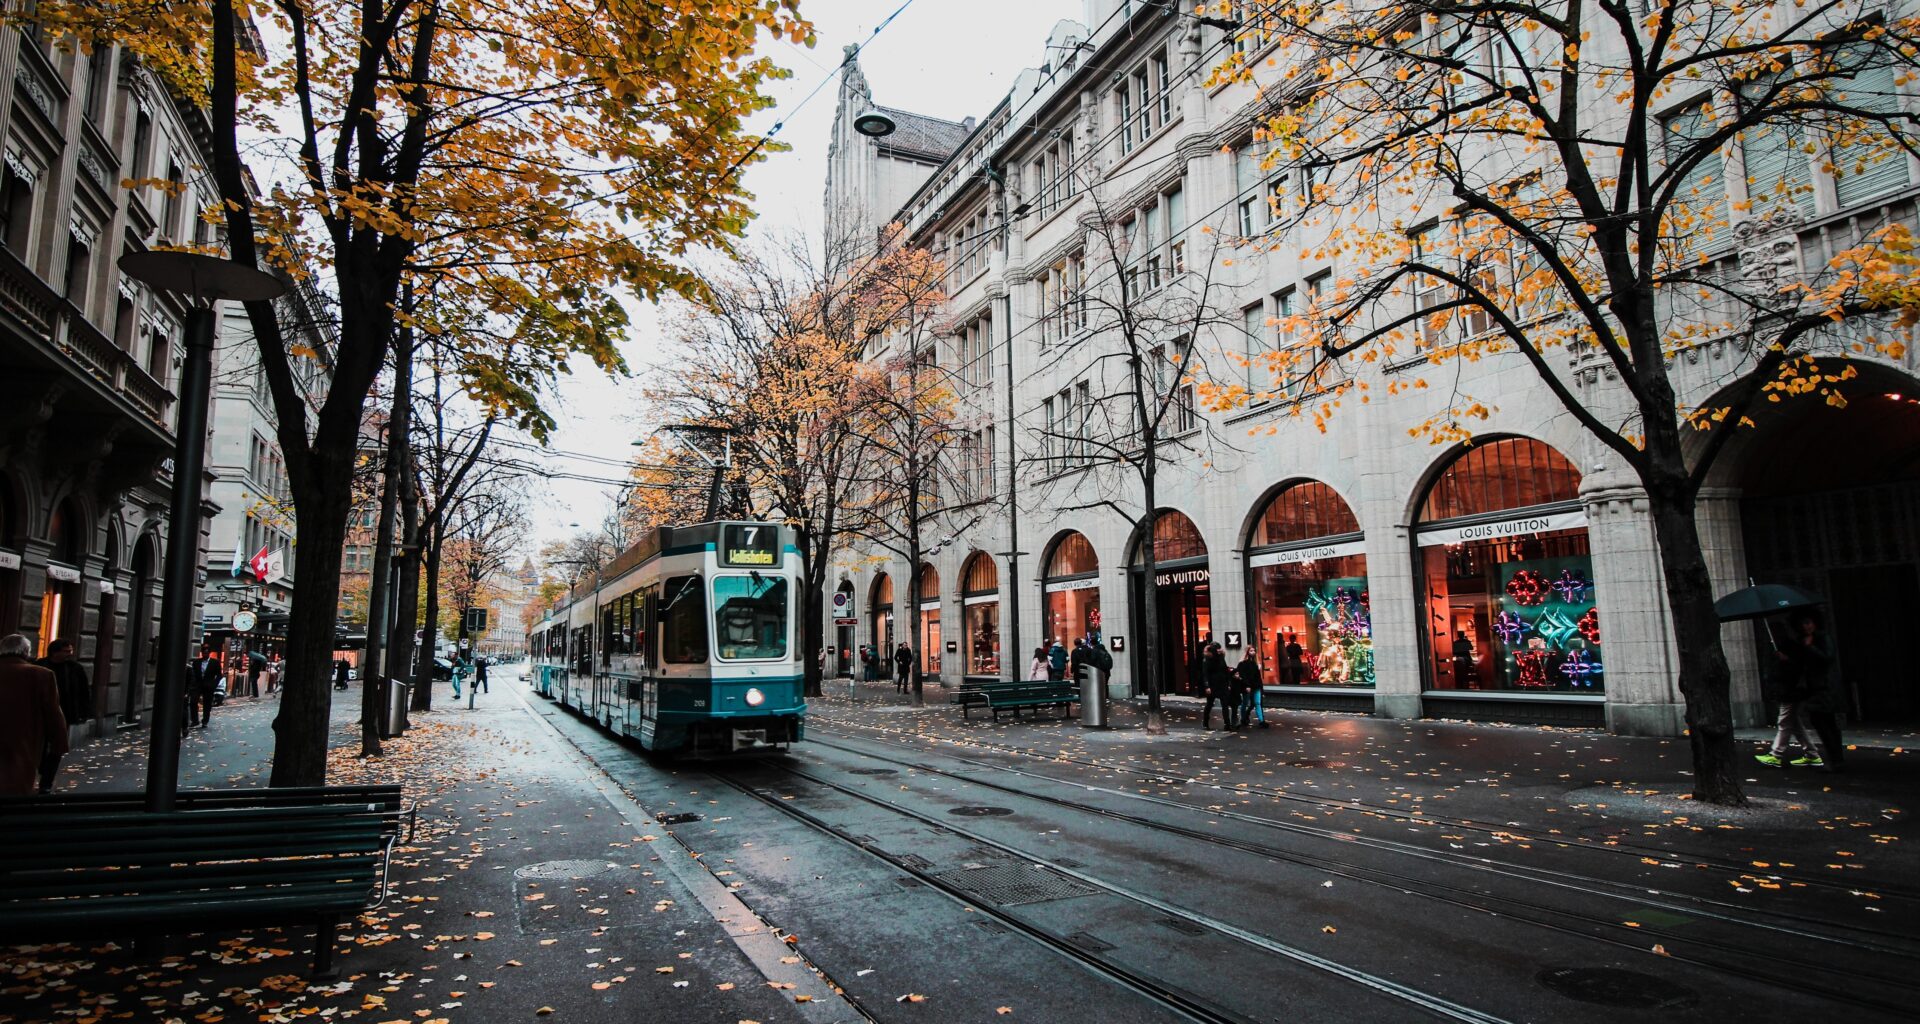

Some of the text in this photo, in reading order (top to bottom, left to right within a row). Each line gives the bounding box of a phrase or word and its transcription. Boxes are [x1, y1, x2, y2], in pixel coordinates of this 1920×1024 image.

[744, 526, 759, 546] 7
[1459, 518, 1550, 539] LOUIS VUITTON
[1277, 547, 1336, 562] LOUIS VUITTON
[1155, 569, 1211, 586] UIS VUITTON
